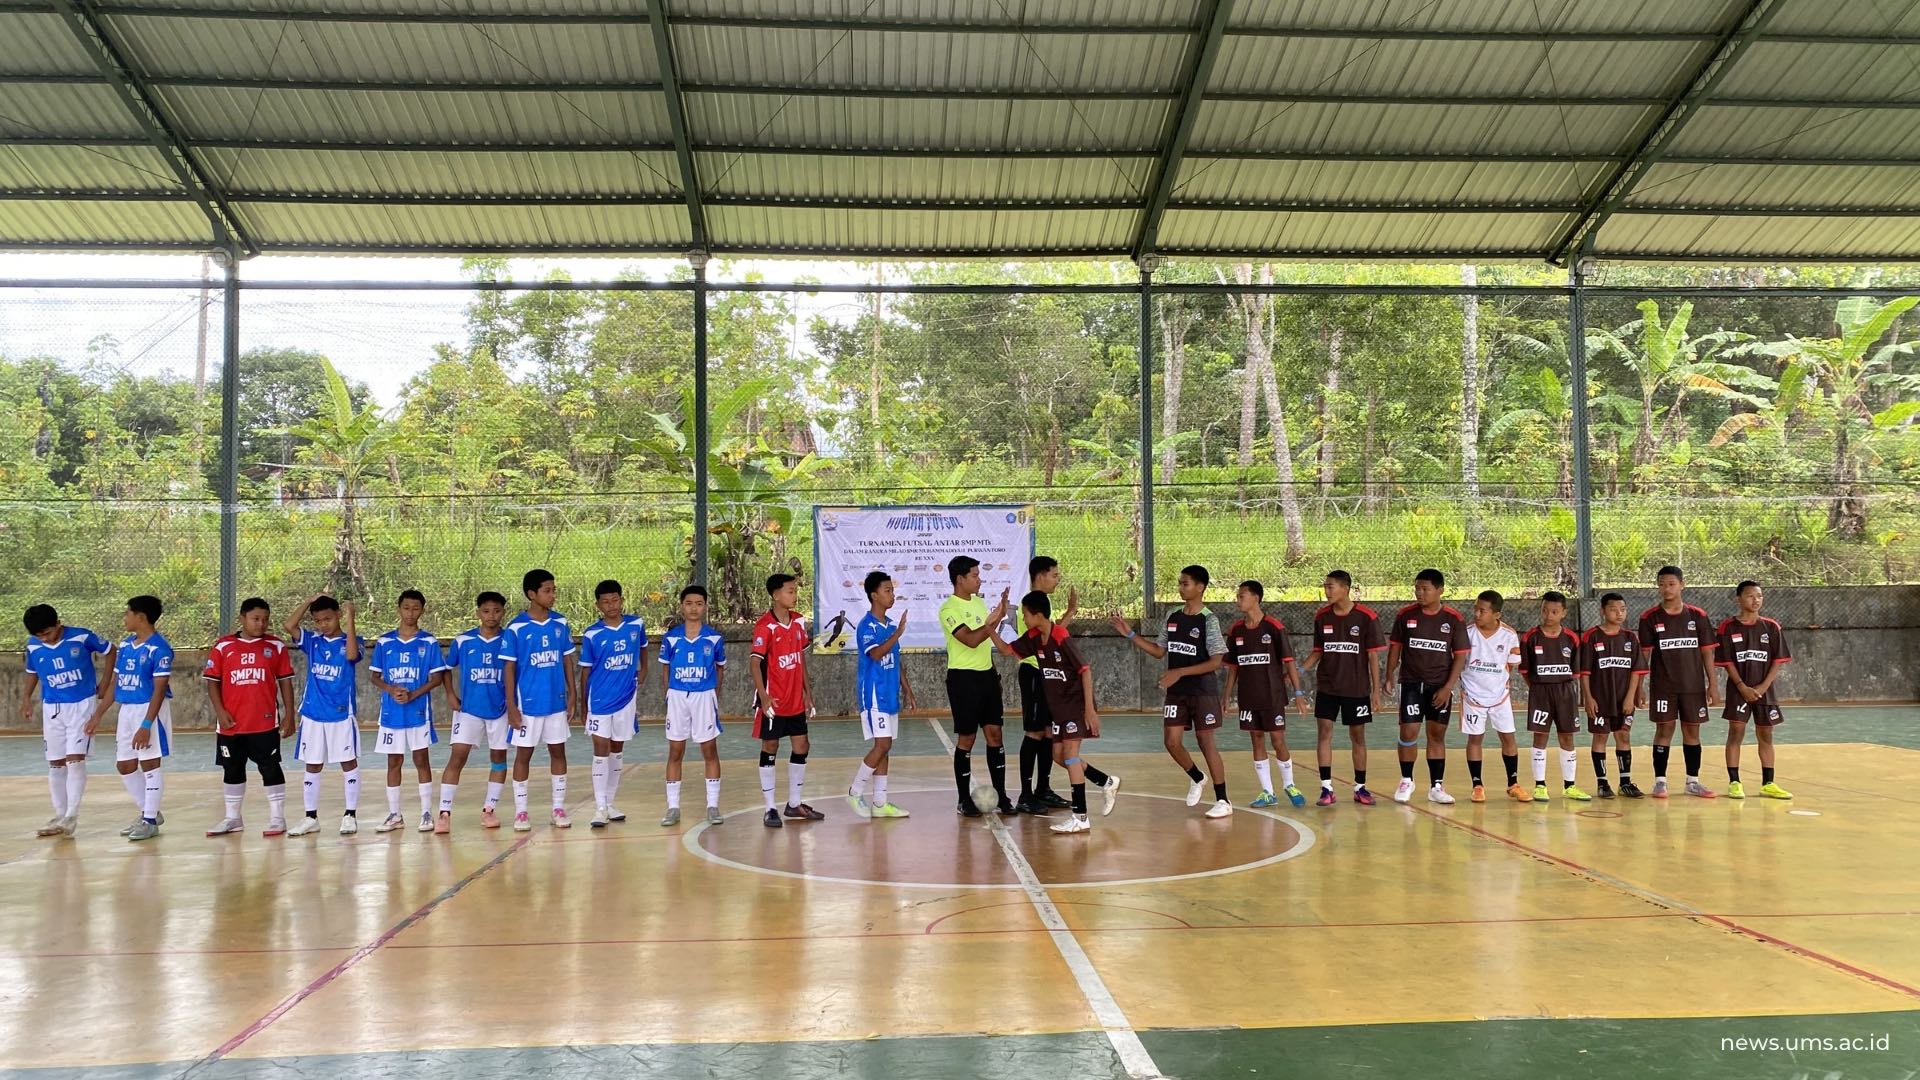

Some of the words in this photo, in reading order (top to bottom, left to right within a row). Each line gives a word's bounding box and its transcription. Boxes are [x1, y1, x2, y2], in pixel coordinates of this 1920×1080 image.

[542, 635, 549, 648] 6
[613, 639, 627, 652] 25
[1324, 643, 1358, 652] SPENDA
[1410, 640, 1446, 651] SPENDA
[1661, 639, 1698, 648] SPENDA
[1169, 643, 1197, 655] SPENDA
[52, 657, 65, 670] 10
[241, 652, 256, 665] 28
[399, 651, 410, 664] 16
[482, 652, 493, 665] 12
[687, 651, 695, 664] 8
[1238, 654, 1270, 664] SPENDA
[1164, 705, 1177, 719] 08
[1356, 705, 1369, 717] 22
[1407, 704, 1420, 716] 05
[1656, 700, 1668, 713] 16
[878, 717, 886, 729] 2
[1466, 714, 1479, 725] 47
[1533, 709, 1549, 726] 02
[1594, 716, 1605, 727] 14
[520, 725, 527, 738] 6
[588, 719, 599, 732] 25
[382, 732, 393, 745] 16
